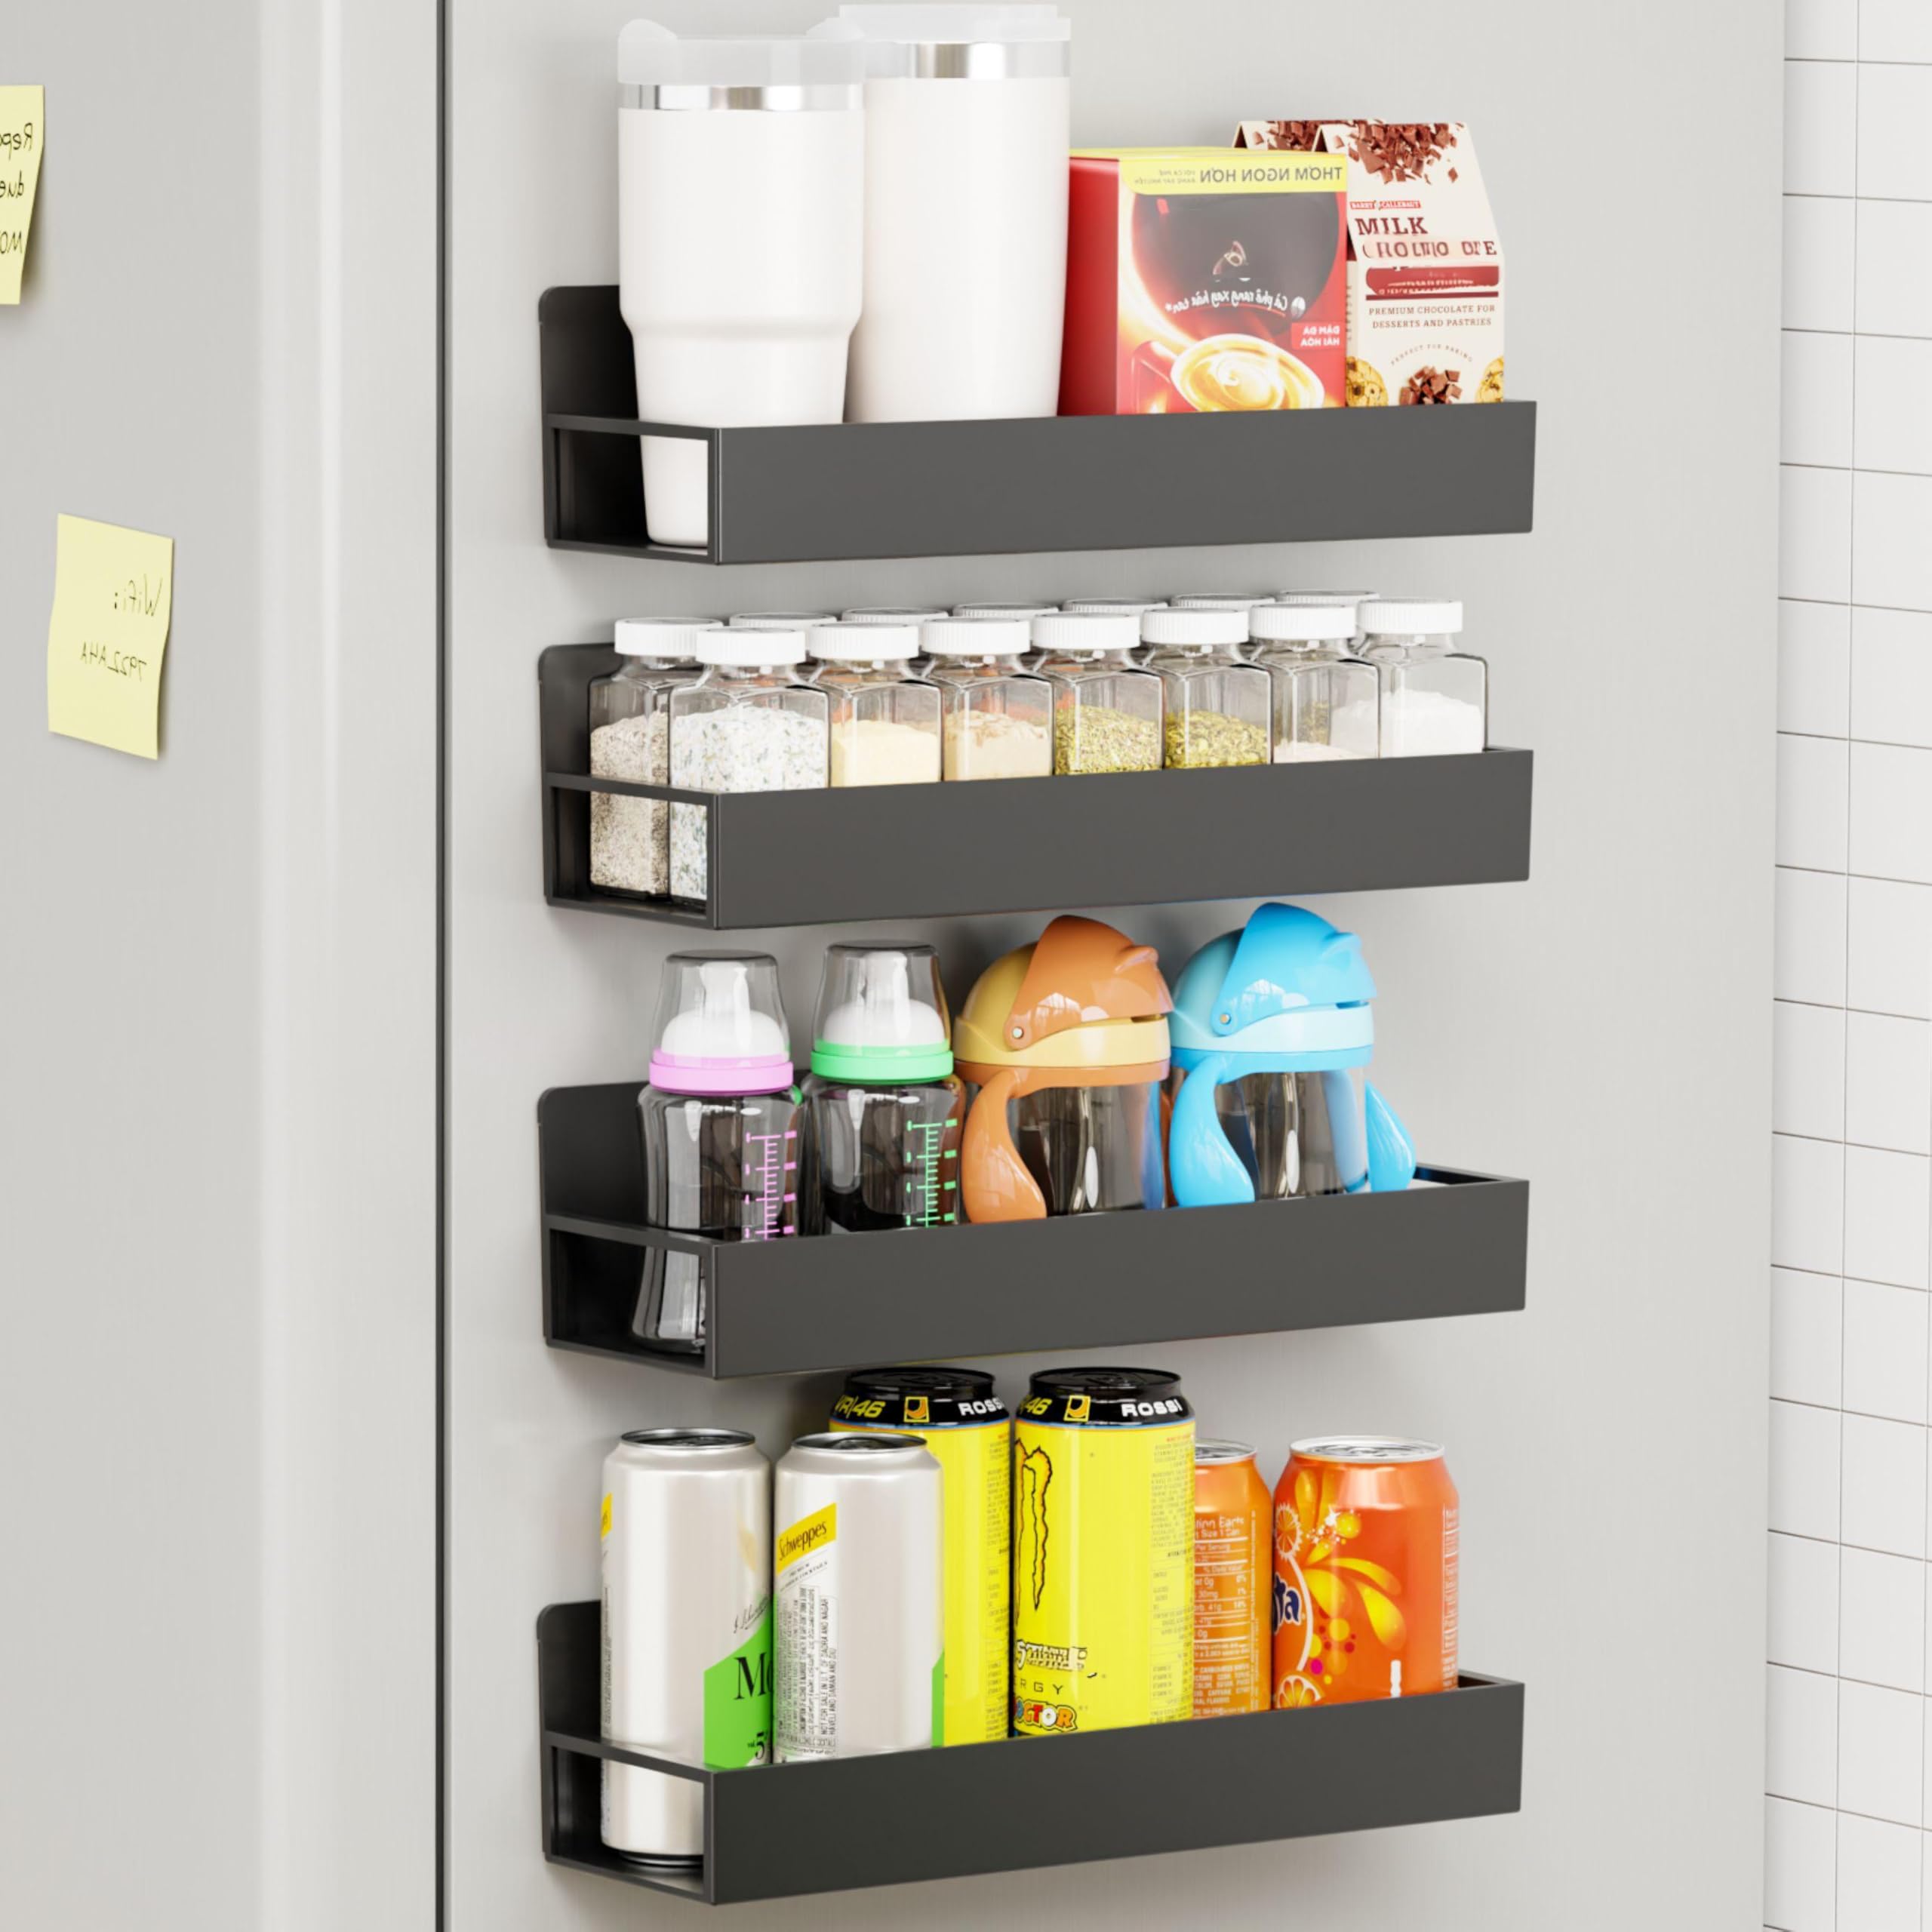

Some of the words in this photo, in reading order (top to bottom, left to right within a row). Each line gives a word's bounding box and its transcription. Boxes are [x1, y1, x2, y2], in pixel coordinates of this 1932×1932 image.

[1355, 217, 1428, 235] MILK
[1369, 307, 1414, 315] PREMIUM
[1417, 306, 1473, 315] CHOCOLATE
[1372, 320, 1420, 328] DESSERTS
[1423, 318, 1444, 327] AND
[1447, 318, 1492, 326] PASTRIES
[958, 1397, 1005, 1416] ROSS
[1121, 1398, 1183, 1417] ROSSI
[779, 1521, 826, 1561] Schweppes
